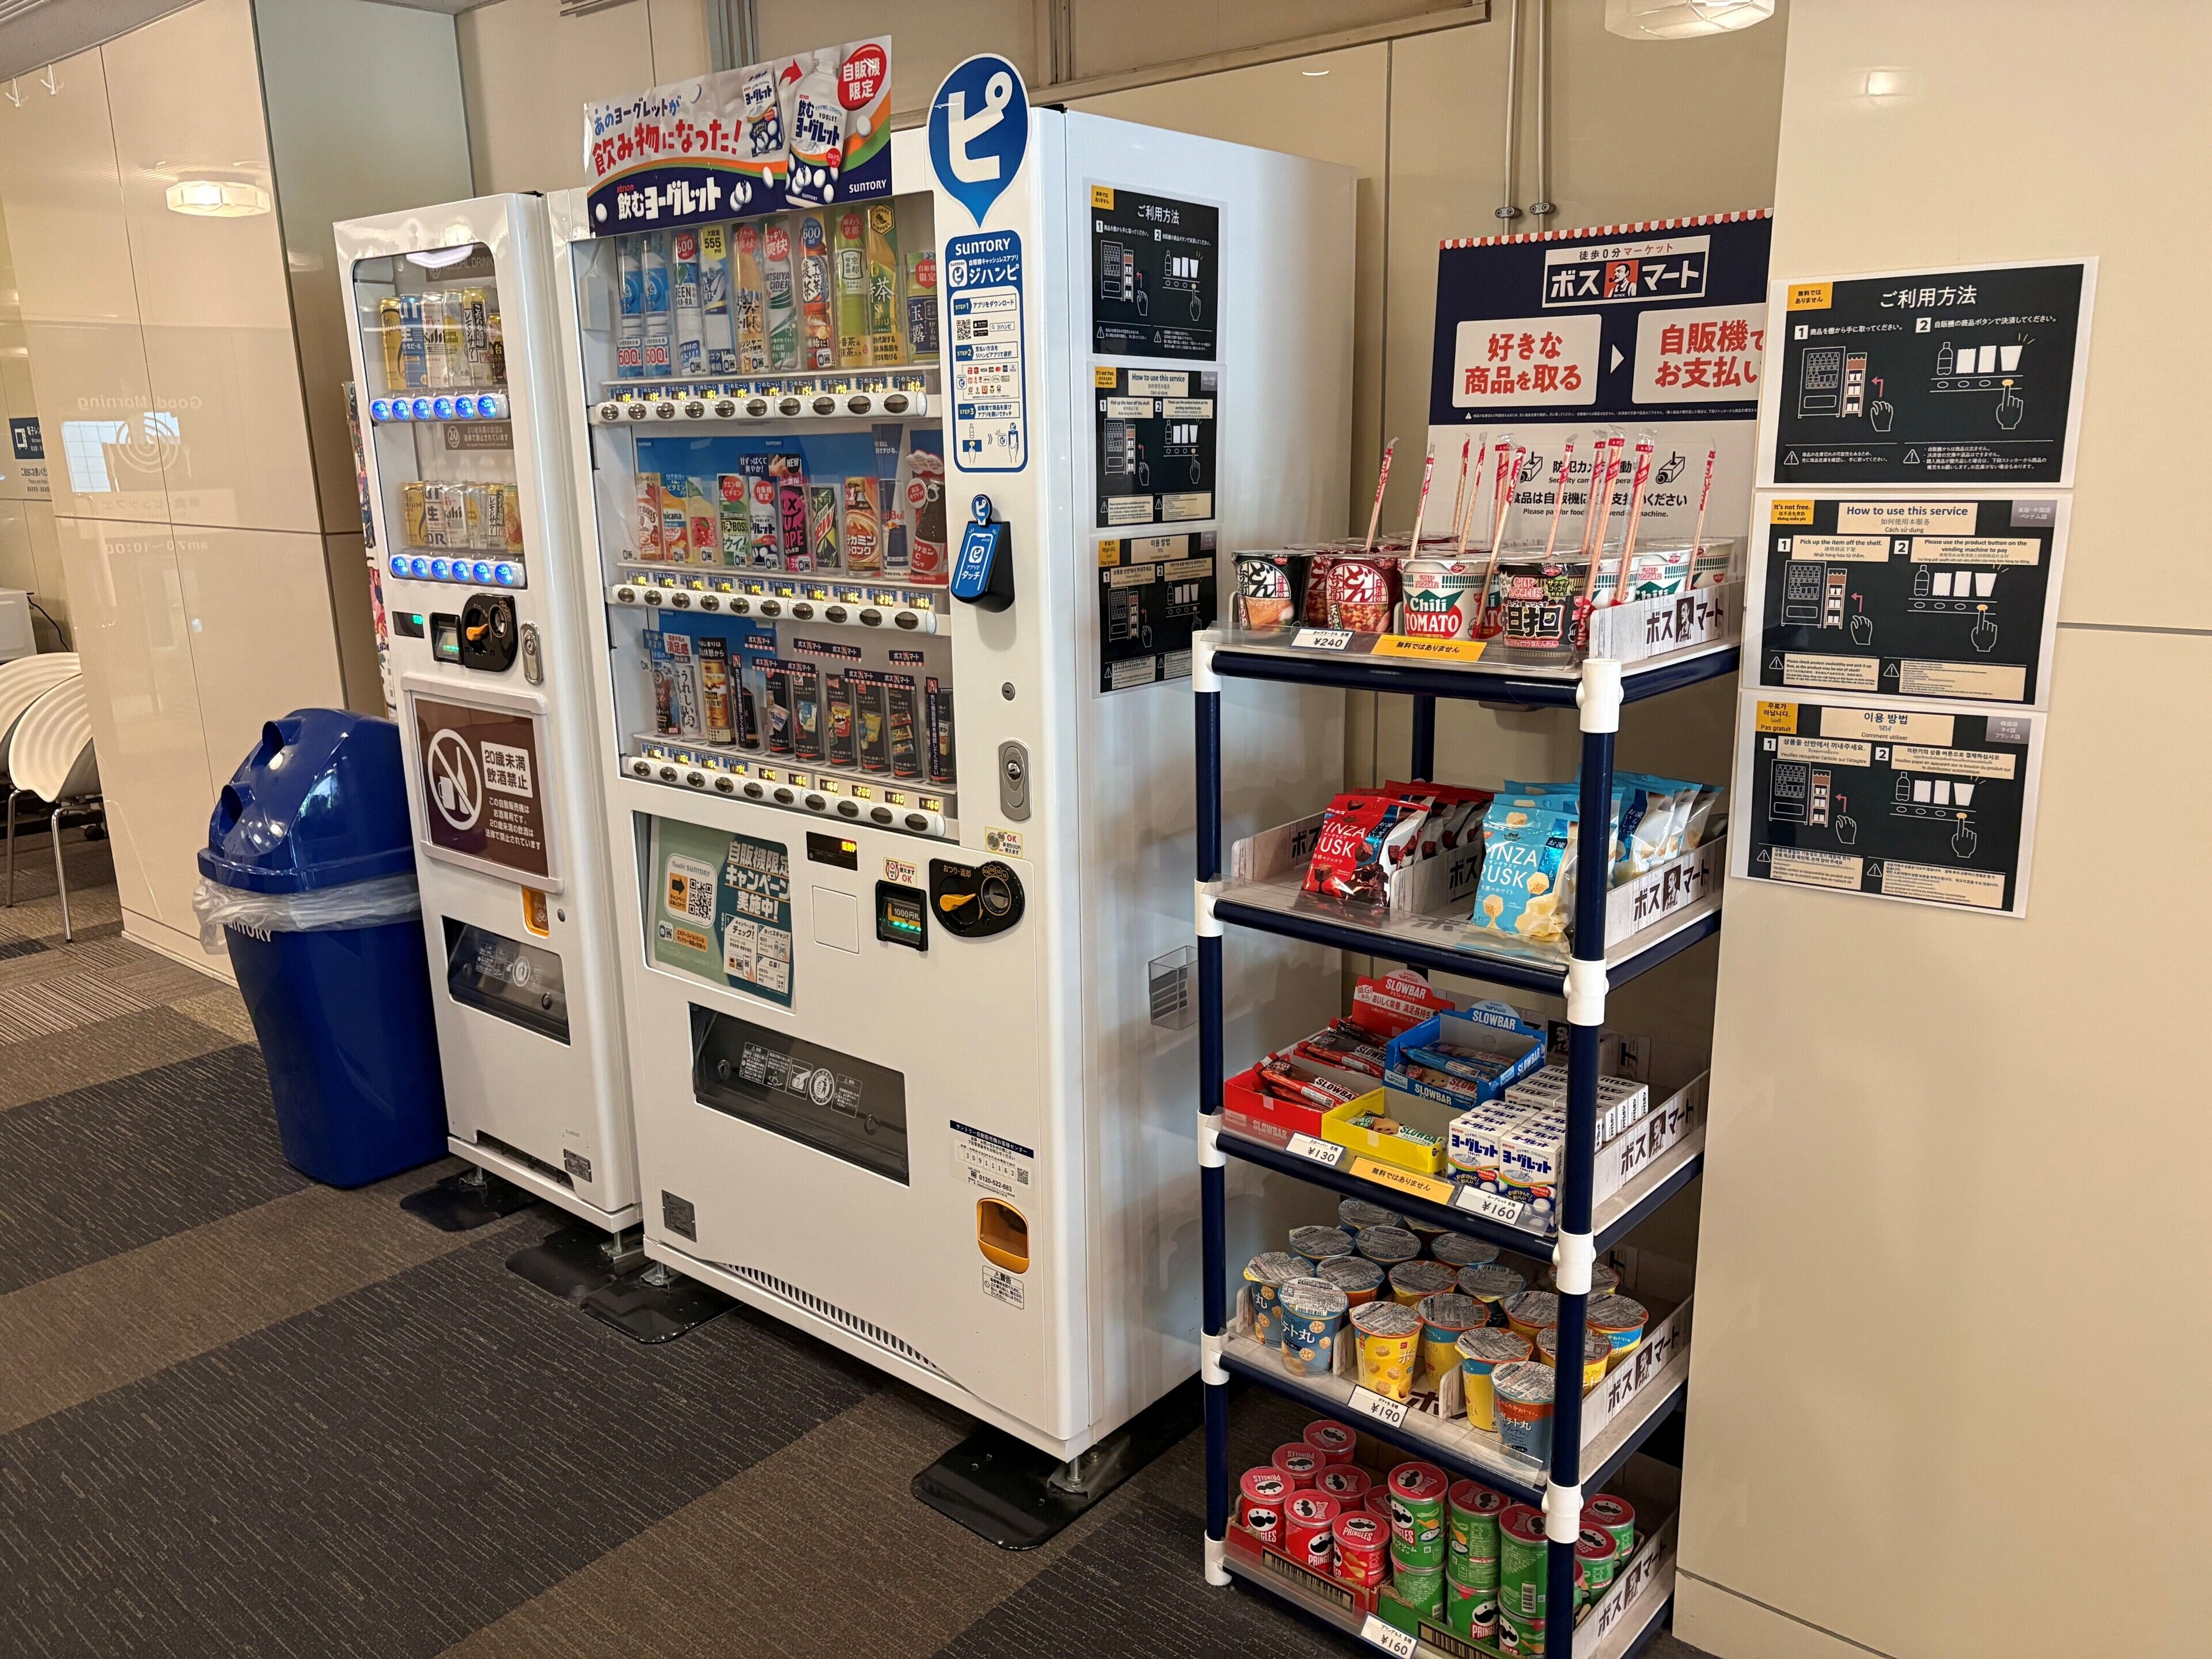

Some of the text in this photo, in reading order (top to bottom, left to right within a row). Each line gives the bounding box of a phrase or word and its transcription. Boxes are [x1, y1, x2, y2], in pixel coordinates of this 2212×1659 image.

[843, 58, 881, 82] 自販機
[849, 80, 875, 102] 限定
[594, 94, 681, 136] あのヨーグレットが
[798, 101, 813, 118] 飲む
[796, 118, 840, 146] ヨーグレット
[948, 71, 1013, 183] ピ
[593, 120, 742, 176] 飲み物になった!
[849, 179, 887, 194] SUNTORY
[617, 177, 721, 220] 飲むヨーグレット
[1137, 204, 1179, 225] ご利用方法
[705, 237, 721, 249] 555
[803, 228, 821, 240] 600
[955, 238, 1010, 255] SUNTORY
[969, 265, 1019, 285] ジハンピ
[1551, 268, 1599, 298] ボス
[770, 281, 790, 290] CIDER
[1797, 289, 1822, 297] 無料では
[973, 300, 1014, 309] アプリをダウンロード
[1795, 296, 1823, 304] ありません
[1880, 285, 1976, 309] ご利用方法
[911, 304, 926, 344] 玉露
[1810, 324, 1903, 336] 商品を棚から手に取ってください。
[1488, 331, 1563, 362] 好きな
[618, 348, 638, 365] 600
[1132, 373, 1141, 381] How
[1464, 363, 1582, 395] 商品を取る
[786, 458, 800, 467] NEW
[1847, 506, 1868, 516] How
[1870, 507, 1881, 516] to
[1907, 506, 1926, 516] this
[1930, 507, 1968, 517] service
[733, 522, 747, 531] BOSS
[962, 571, 980, 580] タッチ
[1513, 577, 1537, 588] CUP
[1508, 586, 1543, 599] NOODLE
[1410, 597, 1446, 613] Chili
[1406, 613, 1460, 632] TOMATO
[1646, 610, 1673, 644] ボス
[1313, 637, 1343, 649] ¥240
[1396, 641, 1460, 654] 無料ではありません
[1864, 713, 1908, 725] 이용 방법
[1783, 738, 1802, 747] 상품을
[484, 750, 525, 771] 20歳未満
[487, 768, 528, 790] 飲酒禁止
[1007, 834, 1017, 843] OK
[728, 841, 789, 875] 自販機限定
[687, 865, 710, 877] SUNTORY
[902, 874, 912, 884] OK
[726, 866, 790, 900] キャンペーン
[737, 891, 779, 921] 実施中!
[1634, 883, 1660, 922] ボス
[1385, 978, 1426, 999] SLOWBAR
[1372, 995, 1431, 1018] おいしく栄養 満足長持ち
[1473, 1010, 1516, 1031] SLOWBAR
[1518, 1047, 1540, 1076] SLOWBAR
[1415, 1084, 1452, 1105] SLOWBAR
[1516, 1087, 1551, 1097] ハイレモン
[1528, 1080, 1563, 1090] ハイレモン
[1253, 1119, 1287, 1140] SLOWBAR
[1308, 1147, 1335, 1163] ¥130
[1452, 1134, 1498, 1158] ヨーグレット
[1503, 1150, 1552, 1174] ヨーグレット
[979, 1175, 1012, 1192] 0120-522-883
[1372, 1166, 1431, 1191] 無料ではありません
[1482, 1200, 1515, 1220] ¥160
[1371, 1404, 1400, 1423] ¥190
[1253, 1474, 1282, 1483] PRINGLES
[1411, 1476, 1438, 1496] PRINGLES
[1342, 1527, 1373, 1542] PRINGLES
[1380, 1637, 1408, 1656] ¥160
